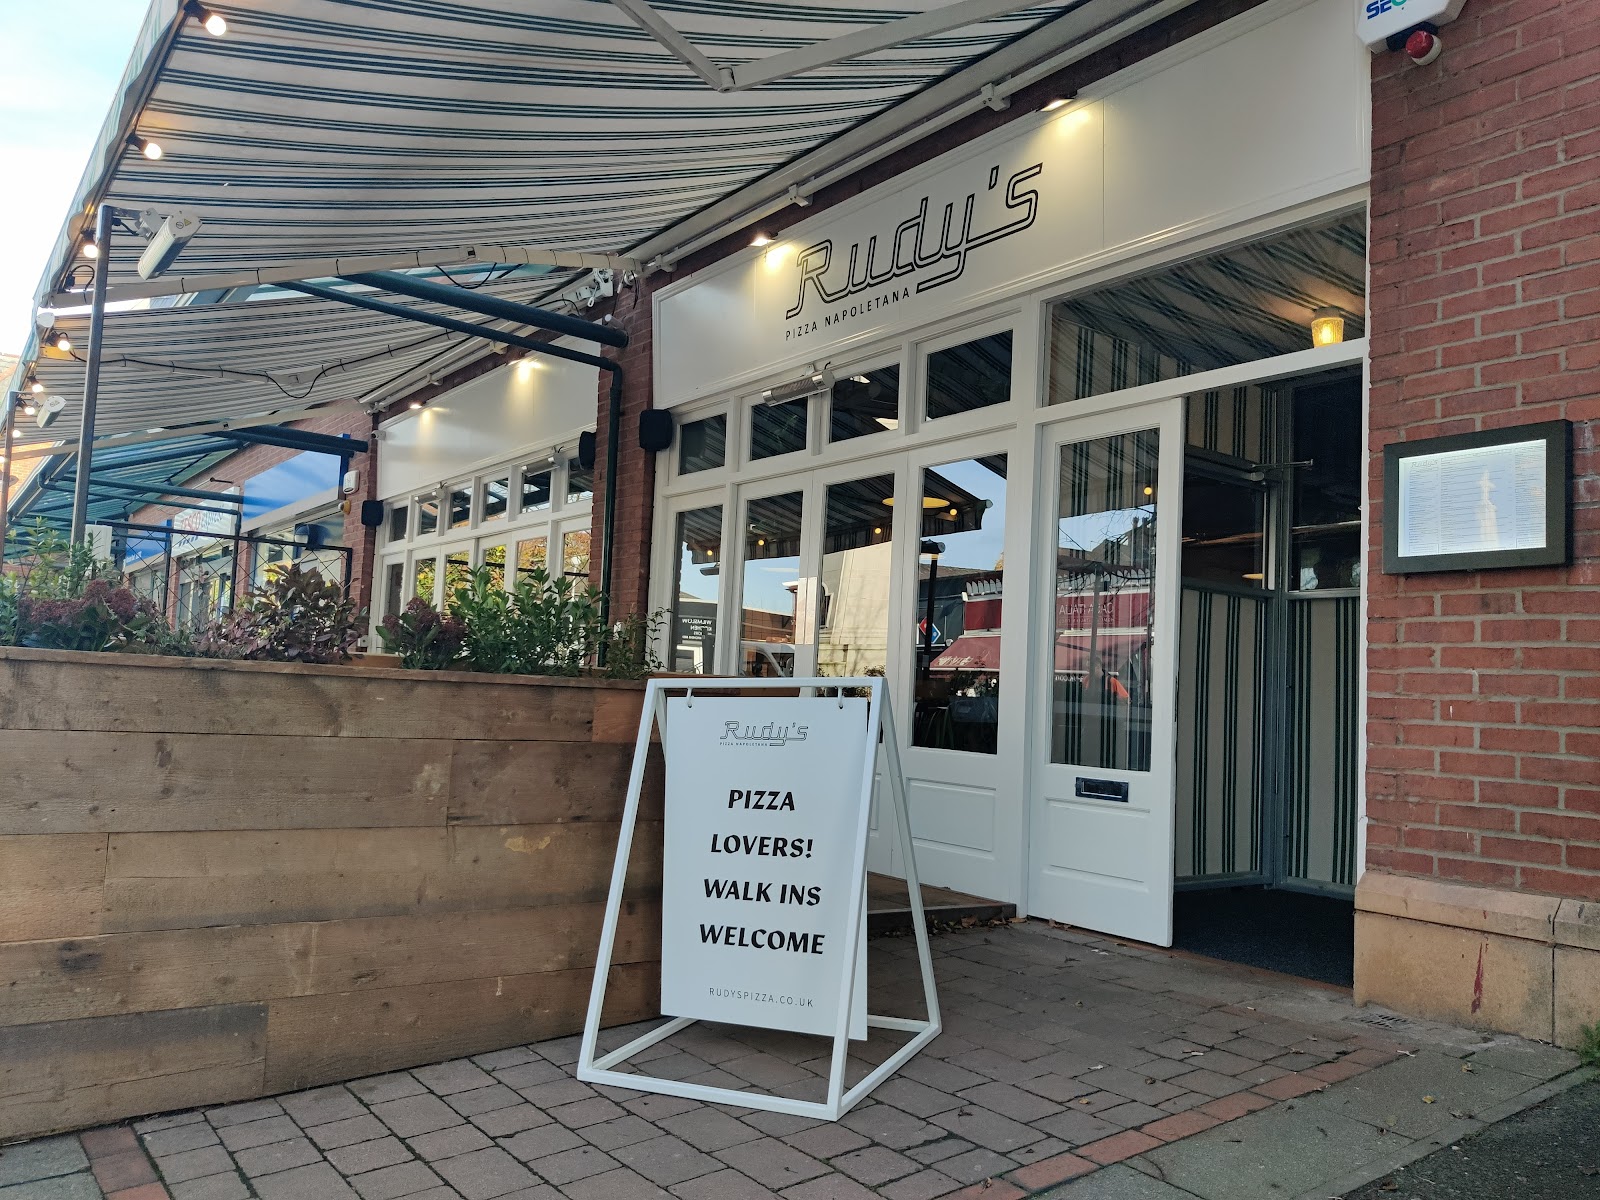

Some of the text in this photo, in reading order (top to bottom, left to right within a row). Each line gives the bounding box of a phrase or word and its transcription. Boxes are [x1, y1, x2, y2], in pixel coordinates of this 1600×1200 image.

[785, 162, 1043, 320] Rudy's
[785, 286, 910, 342] PIZZA NAPOLETANA
[719, 720, 809, 747] Rudy's
[728, 789, 795, 811] PIZZA
[711, 833, 814, 859] LOVERS!
[703, 878, 822, 906] WALK INS
[699, 923, 826, 955] WELCOME
[708, 986, 814, 1008] RUDYSPIZZA.CO.UK
